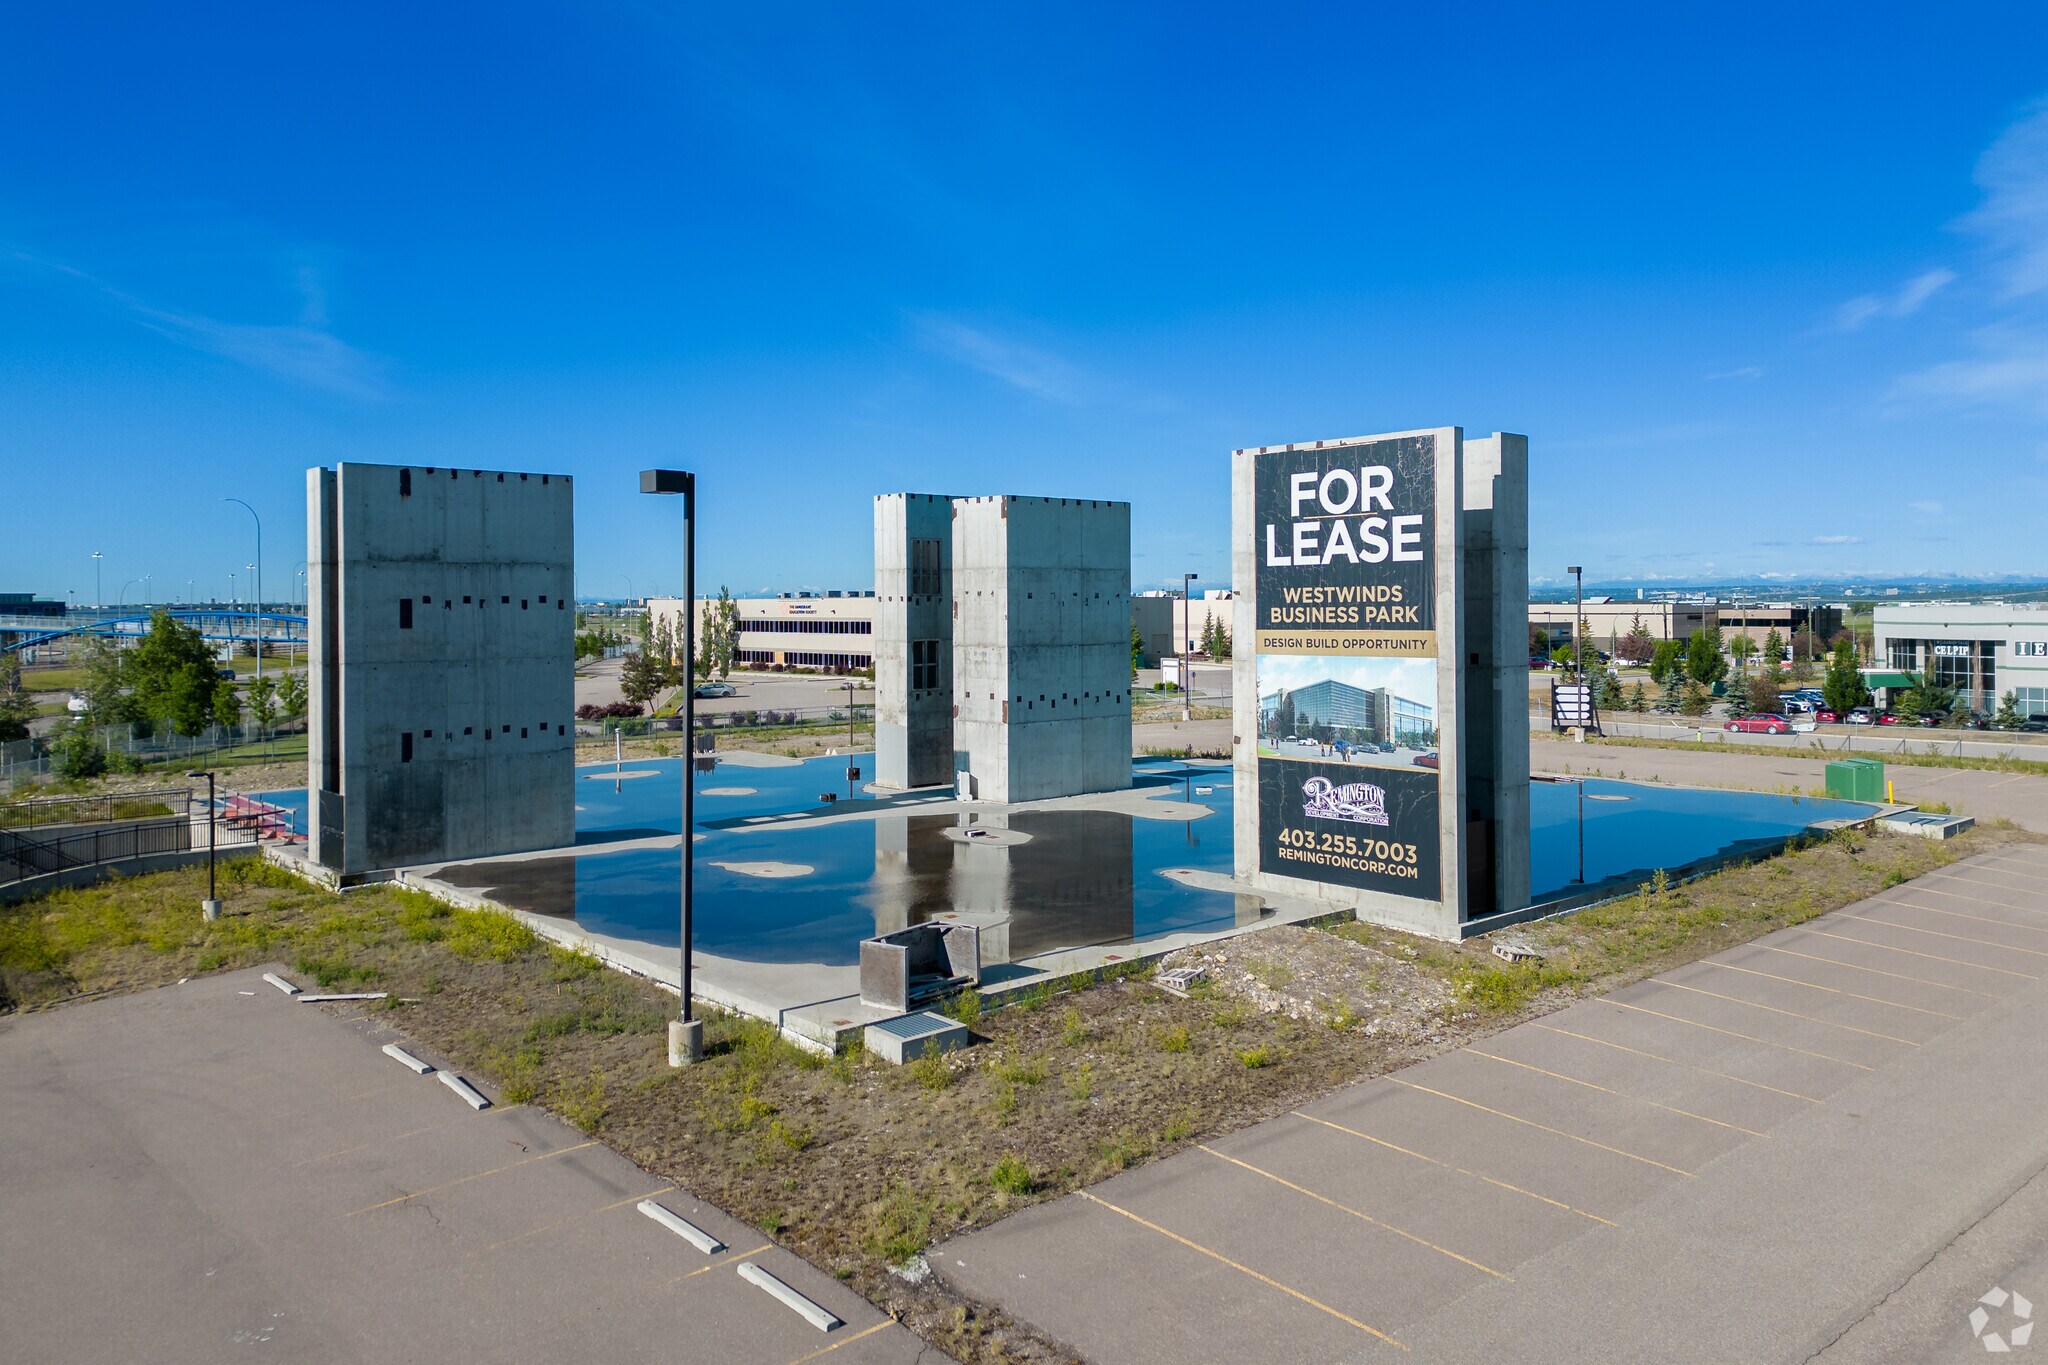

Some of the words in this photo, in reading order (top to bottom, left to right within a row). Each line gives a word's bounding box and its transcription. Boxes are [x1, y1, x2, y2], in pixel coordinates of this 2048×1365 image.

[1290, 465, 1394, 517] FOR
[1266, 514, 1424, 567] LEASE
[1283, 585, 1402, 603] WESTWINDS
[1270, 605, 1360, 624] BUSINESS
[1365, 605, 1420, 623] PARK
[1263, 637, 1303, 650] DESIGN
[1305, 638, 1339, 650] BUILD
[1342, 638, 1428, 651] OPPORTUNITY
[1935, 645, 1968, 655] CELPIP
[1302, 776, 1386, 813] REMINGTON
[1278, 828, 1418, 864] 403.255.7003
[1278, 847, 1418, 879] REMINGTONCORP.COM
